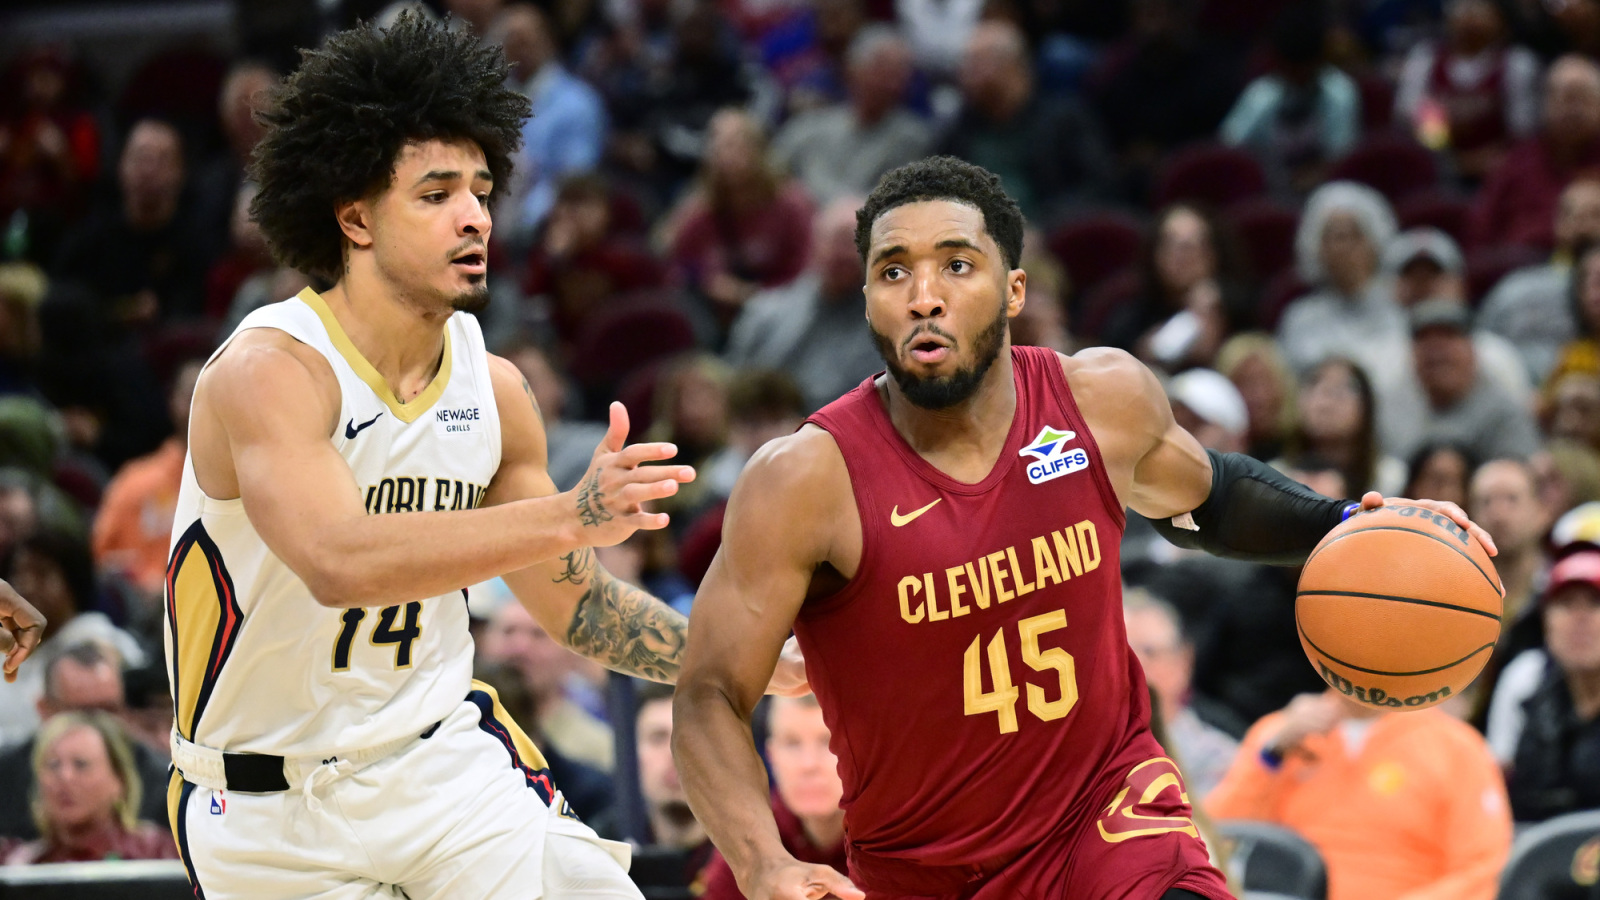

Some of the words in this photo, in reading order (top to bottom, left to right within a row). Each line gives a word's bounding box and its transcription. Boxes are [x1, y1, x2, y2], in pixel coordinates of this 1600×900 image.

[436, 408, 480, 422] NEWAGE
[446, 424, 471, 432] GRILLS
[1029, 452, 1087, 480] CLIFFS
[374, 476, 487, 513] OREAN
[897, 519, 1102, 624] CLEVELAND
[331, 600, 424, 673] 14
[963, 608, 1079, 735] 45
[1317, 659, 1453, 708] Wilson
